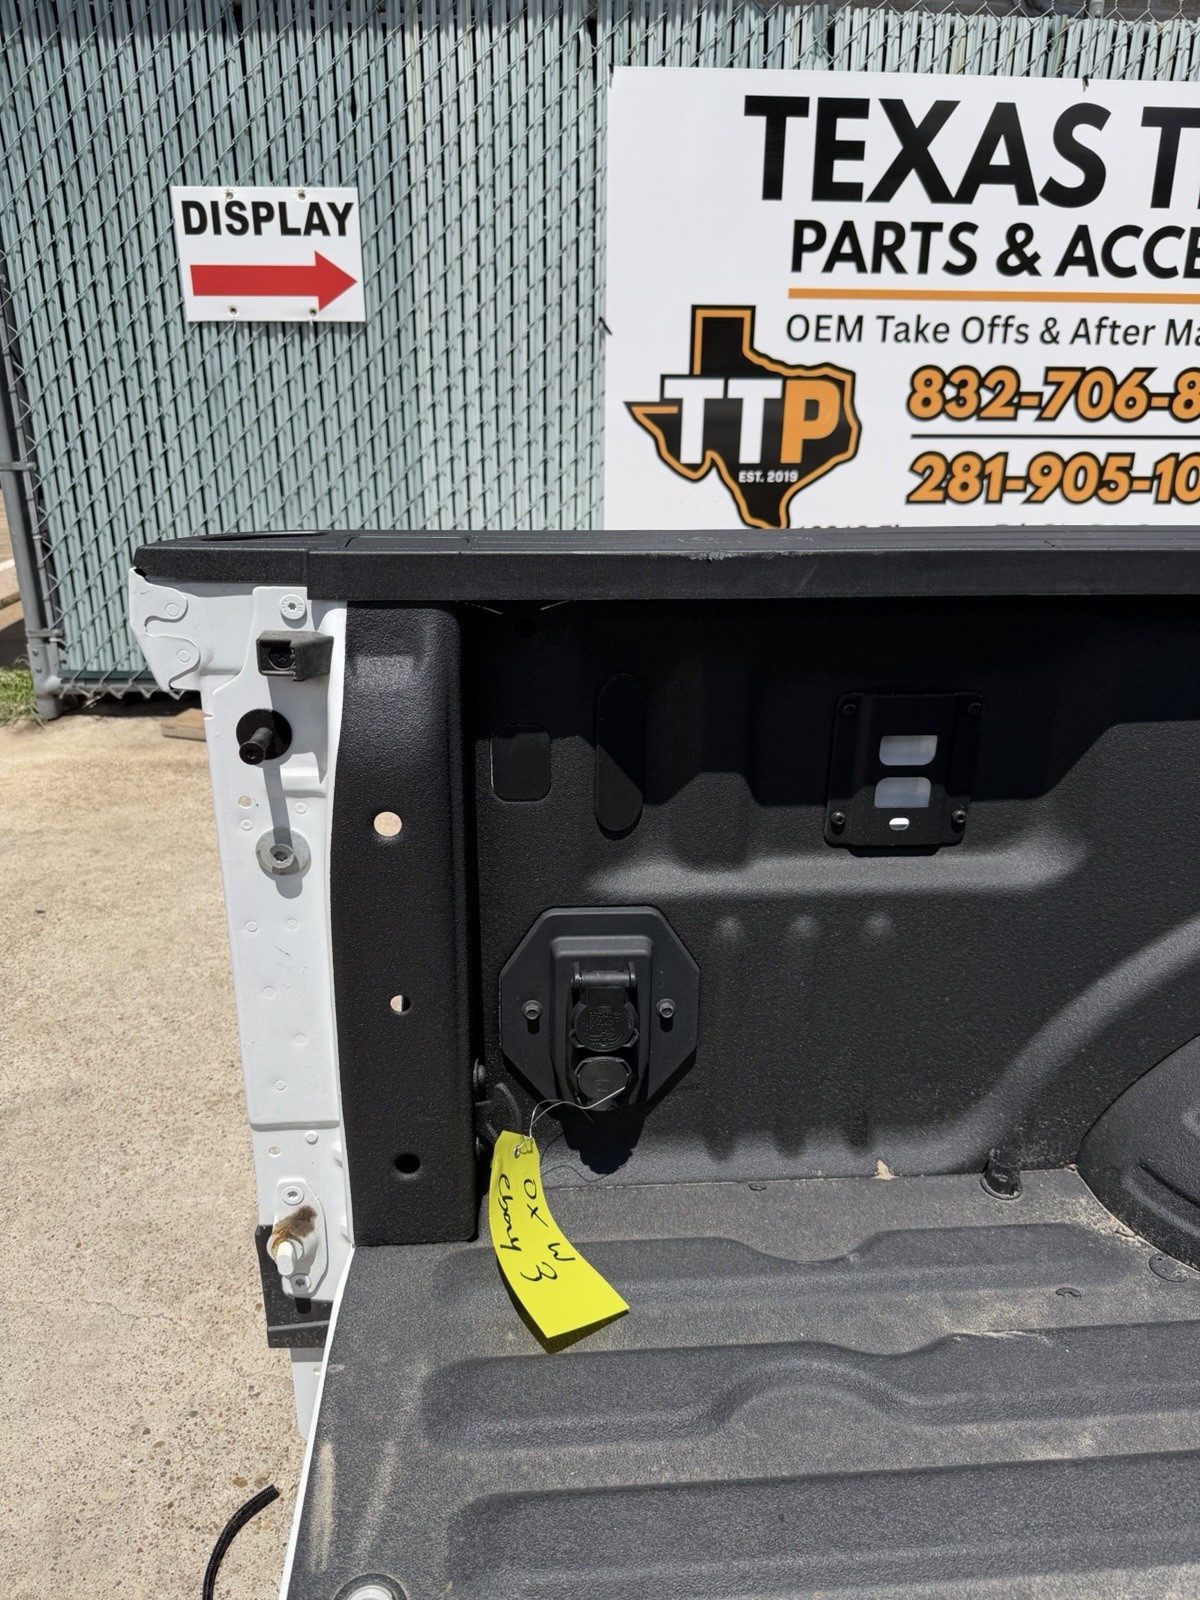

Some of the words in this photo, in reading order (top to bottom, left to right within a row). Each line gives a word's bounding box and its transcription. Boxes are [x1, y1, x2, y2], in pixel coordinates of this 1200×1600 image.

[744, 95, 1112, 209] TEXAS
[1140, 106, 1200, 210] T
[181, 200, 355, 237] DISPLAY
[790, 219, 979, 276] PARTS
[995, 222, 1043, 277] &
[786, 313, 864, 343] OEM
[876, 314, 951, 343] Take
[961, 314, 1030, 345] Offs
[1039, 316, 1061, 345] &
[1069, 316, 1156, 346] After
[663, 377, 841, 465] TTP
[905, 364, 1200, 423] 832-706-8
[738, 470, 764, 484] EST.
[766, 470, 799, 484] 2019
[905, 450, 1200, 506] 281-905-10
